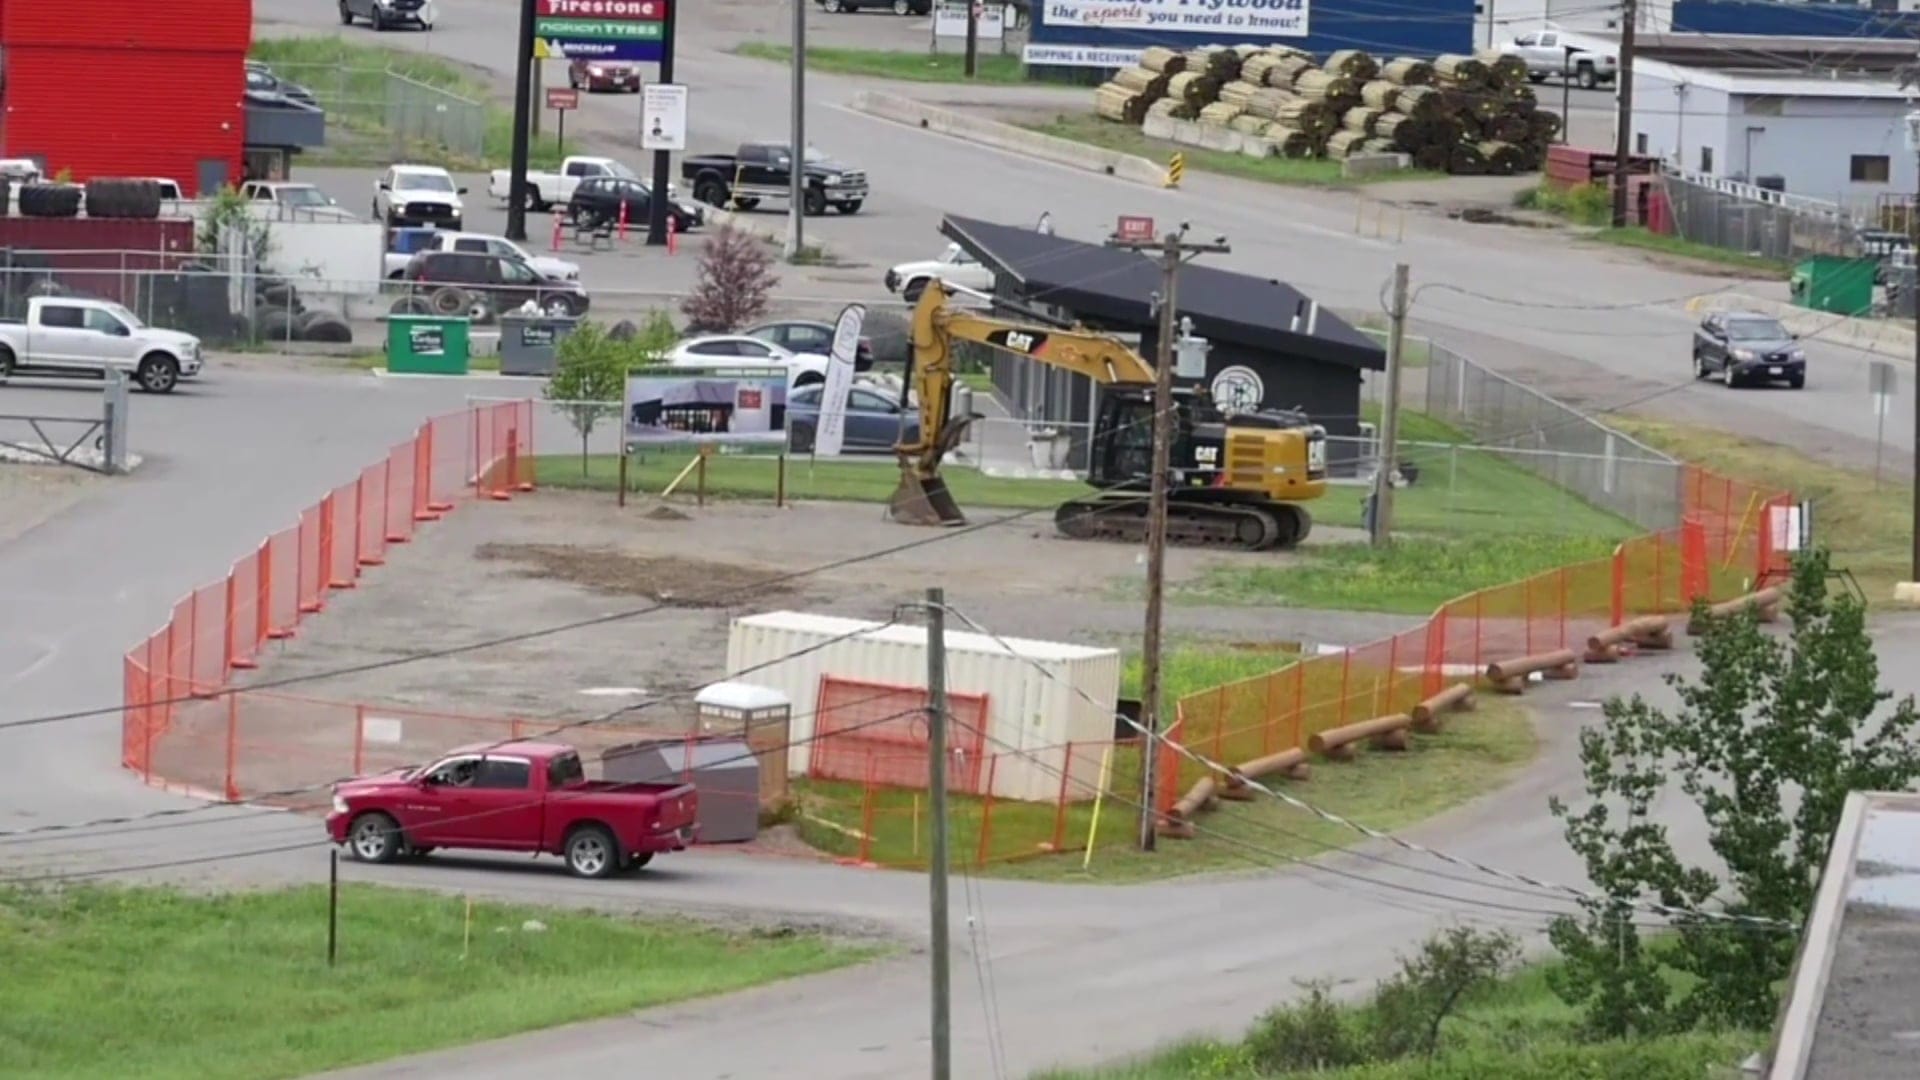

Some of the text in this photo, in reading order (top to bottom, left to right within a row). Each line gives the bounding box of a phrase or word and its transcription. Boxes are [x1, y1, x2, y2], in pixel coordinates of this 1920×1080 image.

[549, 0, 654, 14] Firestone
[1052, 4, 1300, 29] the experts you need to know!
[603, 23, 658, 35] TYRES
[563, 42, 617, 53] MICHELIN
[1028, 49, 1138, 63] SHIPPING & RECEIVING
[1006, 330, 1034, 353] CAT
[1195, 446, 1218, 461] CAT
